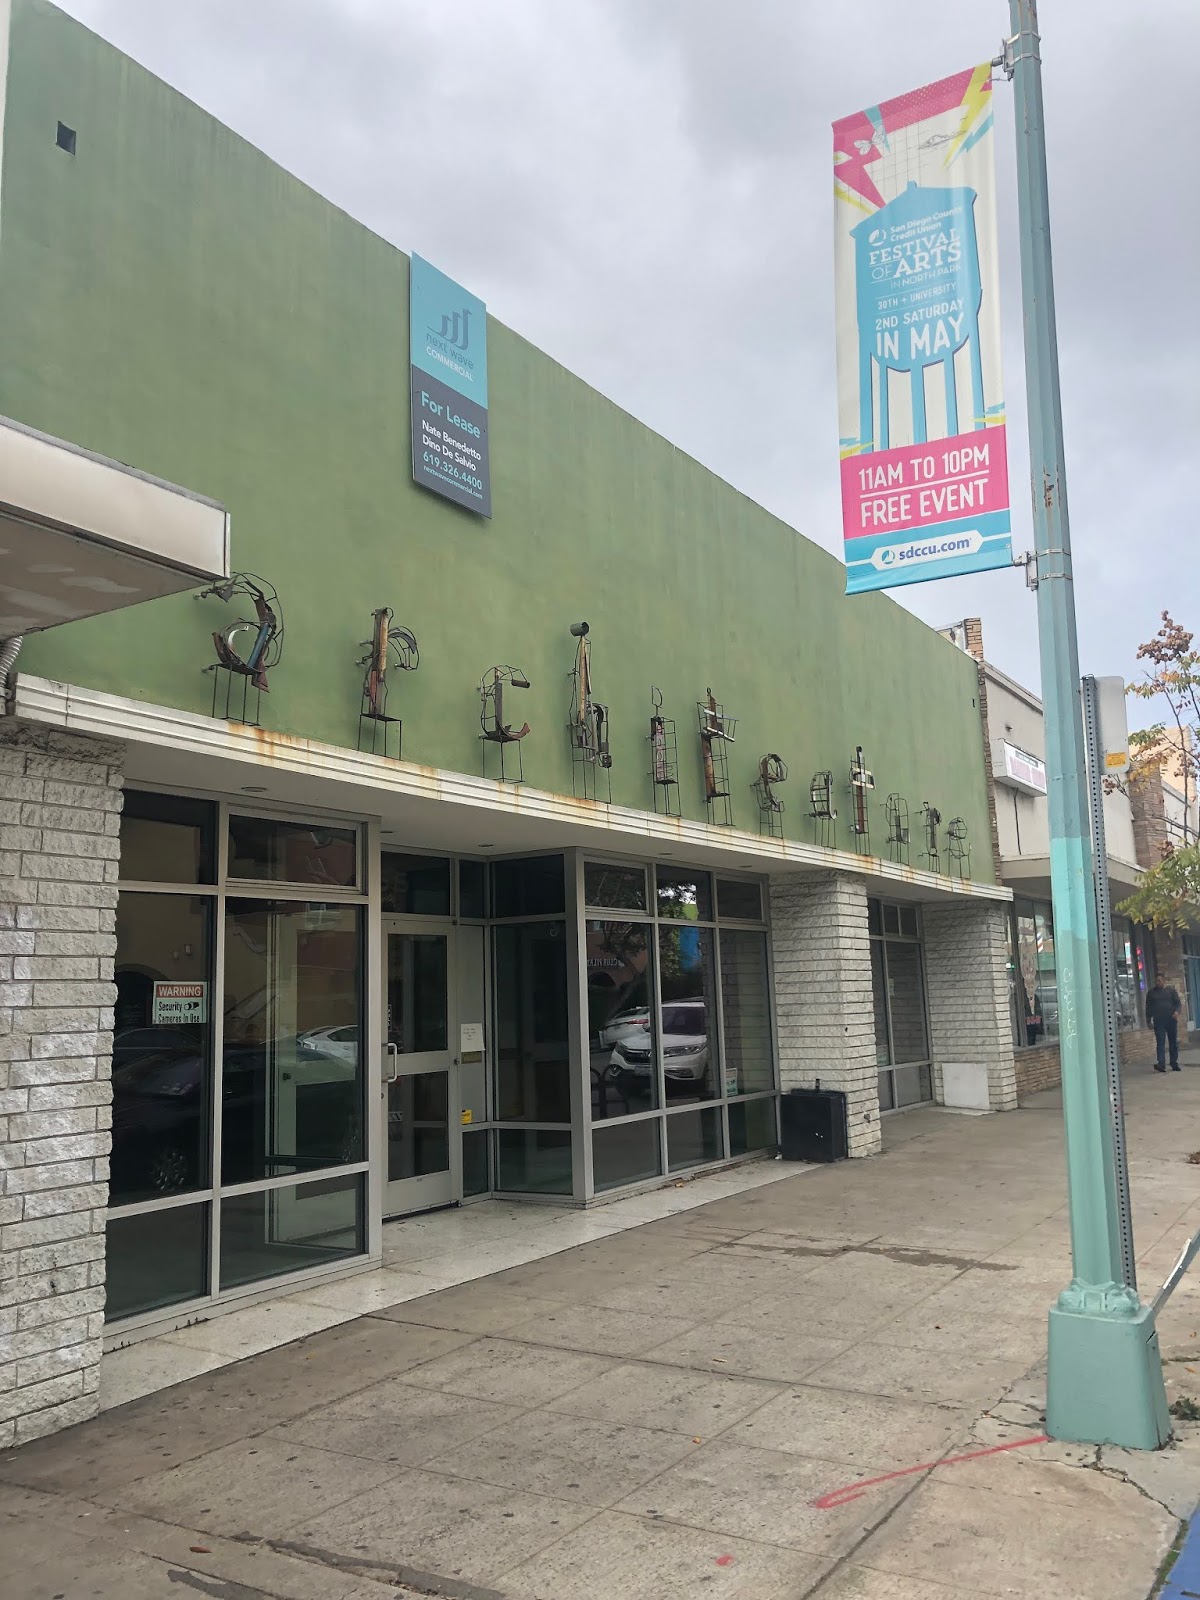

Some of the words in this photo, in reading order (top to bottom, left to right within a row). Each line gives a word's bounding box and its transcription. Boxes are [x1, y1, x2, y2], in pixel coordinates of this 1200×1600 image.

[890, 224, 906, 234] San
[907, 217, 931, 230] Diego
[890, 230, 916, 242] Credit
[917, 222, 942, 234] Union
[869, 228, 960, 266] FESTIVAL
[872, 265, 894, 280] OF
[893, 240, 961, 278] ARTS
[890, 279, 900, 290] IN
[902, 270, 935, 287] NORTH
[937, 264, 962, 276] PARK
[878, 298, 898, 310] 30TH
[910, 282, 957, 302] UNIVERSITY
[876, 315, 898, 330] 2ND
[903, 298, 964, 325] SATURDAY
[426, 333, 448, 356] next
[450, 348, 474, 370] wave
[876, 330, 899, 360] IN
[910, 312, 964, 360] MAY
[426, 347, 474, 382] COMMERCIAL
[421, 390, 443, 417] For
[446, 406, 481, 438] Lease
[422, 420, 442, 440] Nate
[443, 430, 481, 460] Benedetto
[422, 436, 441, 454] Dino
[442, 446, 453, 459] De
[455, 450, 476, 472] Salvio
[423, 452, 482, 490] 619.326.4400
[858, 462, 904, 491] 11AM
[910, 456, 935, 481] TO
[942, 443, 990, 475] 10PM
[860, 494, 912, 528] FREE
[920, 478, 989, 517] EVENT
[899, 538, 970, 561] sdccu.com
[158, 986, 201, 996] WARNING
[158, 1002, 182, 1013] Security
[158, 1014, 182, 1023] Cameras
[190, 1014, 200, 1022] Use
